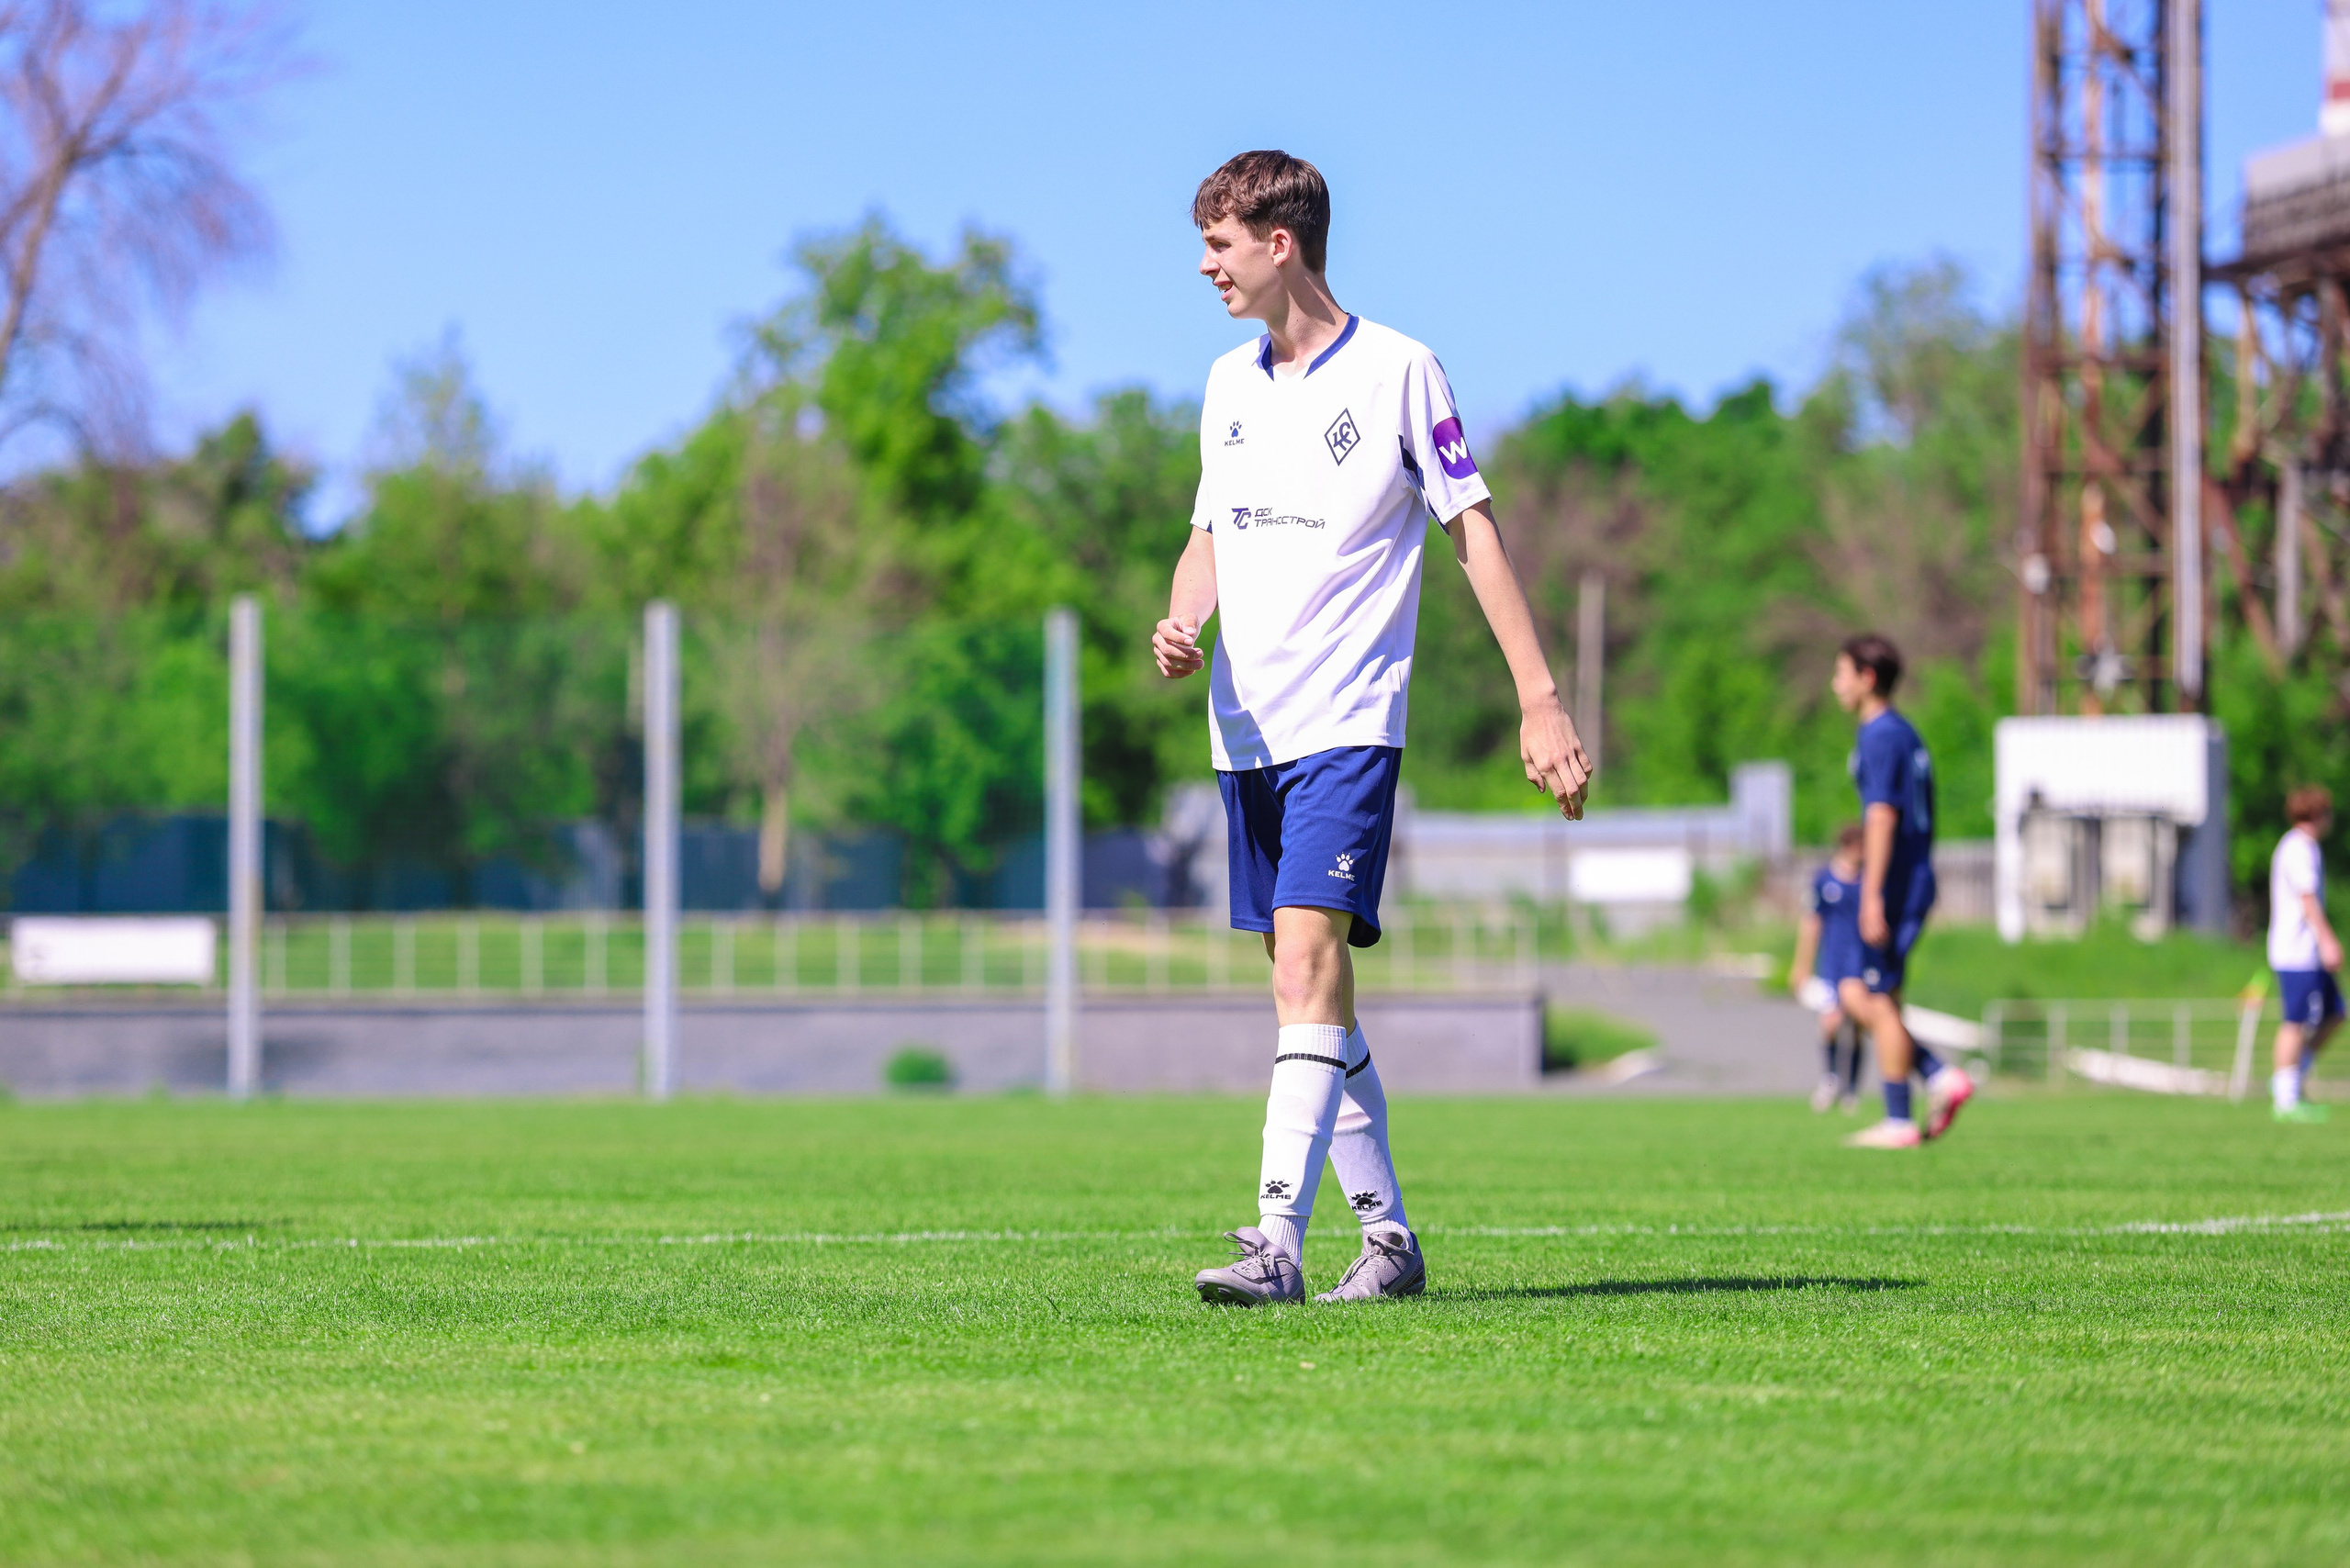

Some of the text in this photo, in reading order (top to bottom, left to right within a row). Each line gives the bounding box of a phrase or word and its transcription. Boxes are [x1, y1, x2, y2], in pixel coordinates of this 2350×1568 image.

[1224, 438, 1245, 447] KELME
[1438, 436, 1468, 465] W
[1327, 869, 1356, 881] KELME
[1351, 1200, 1383, 1211] KELME
